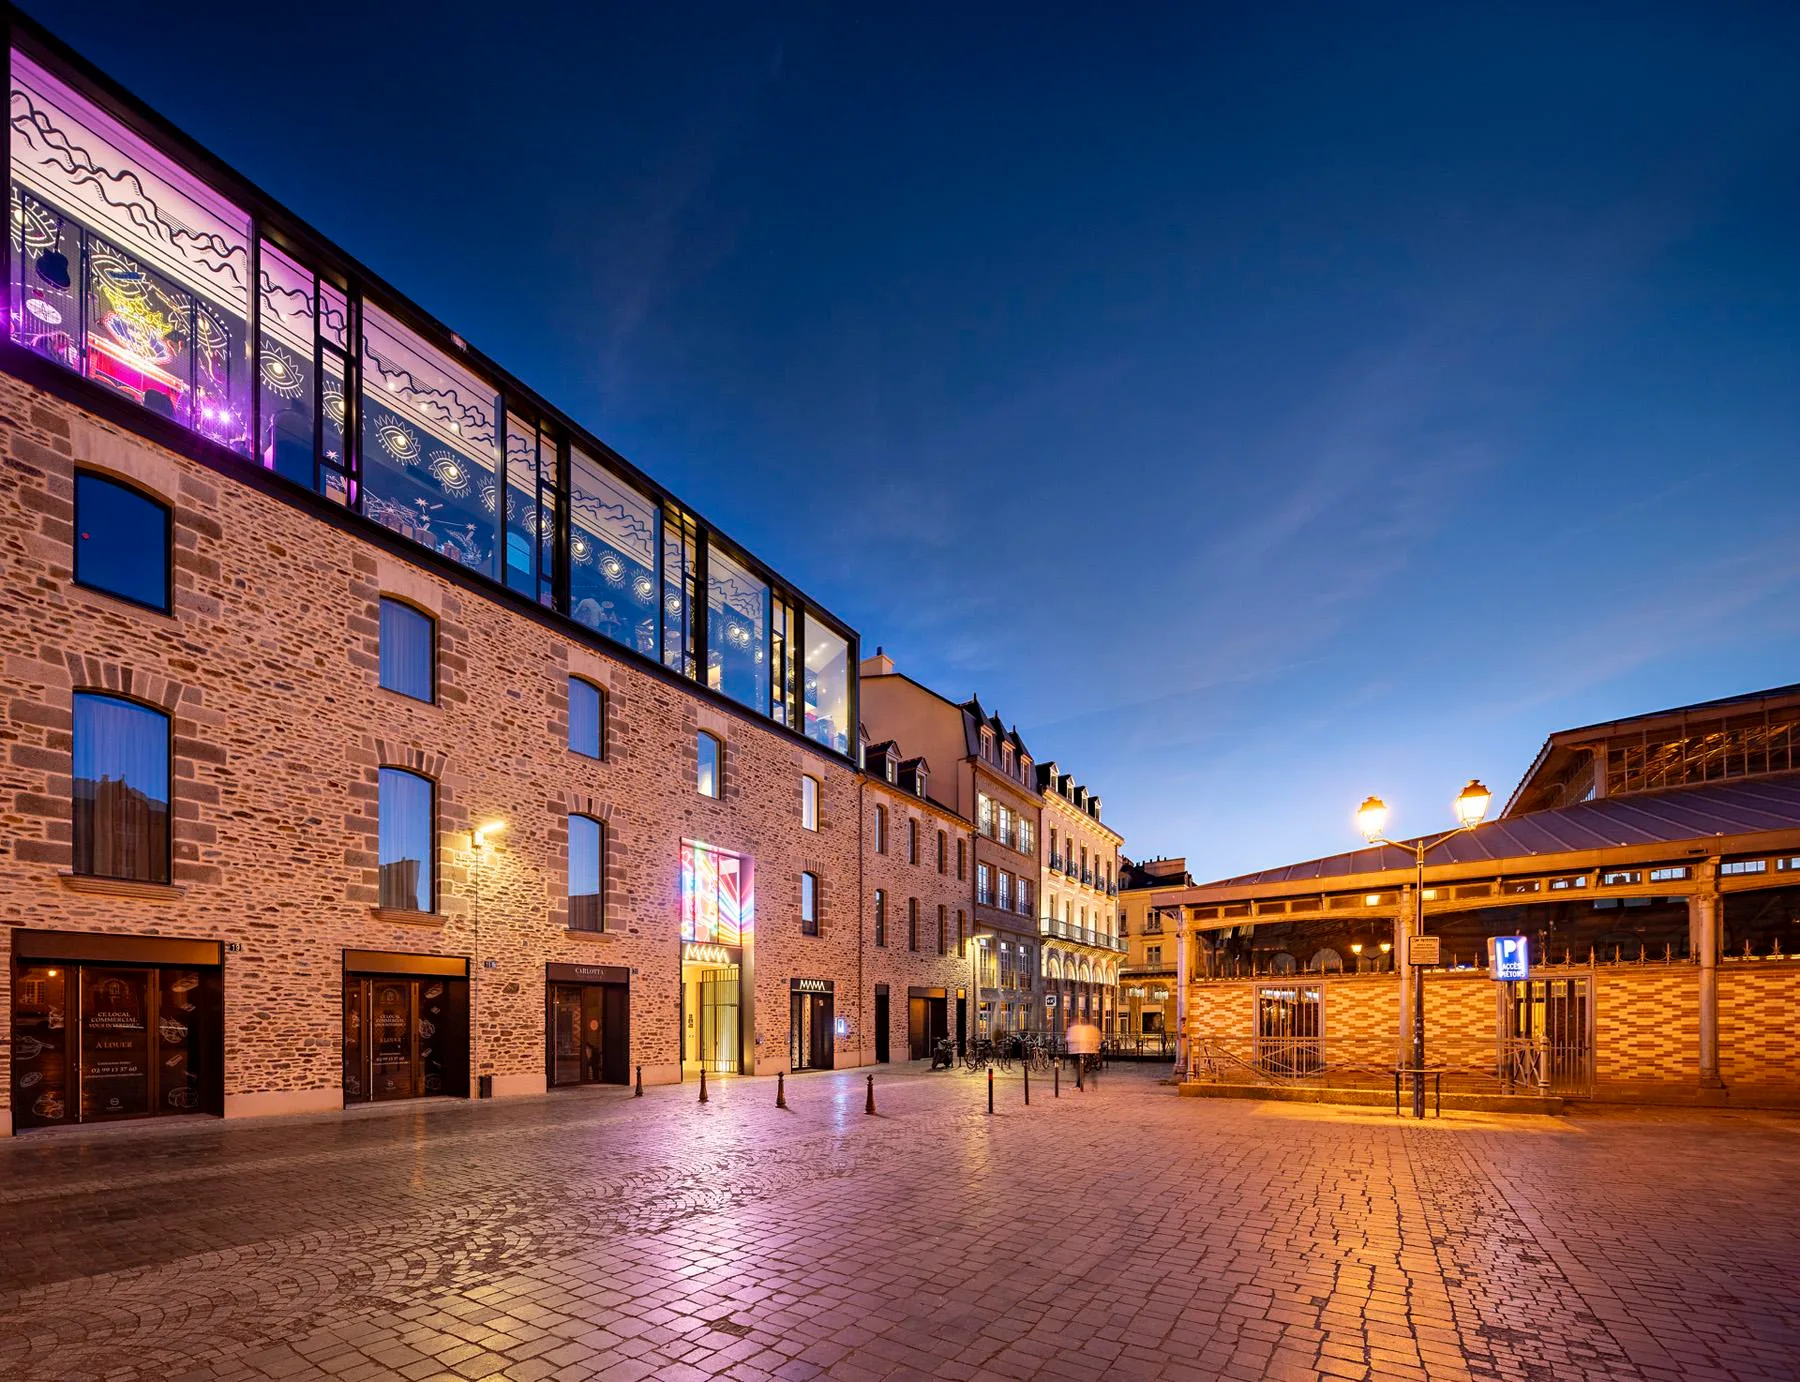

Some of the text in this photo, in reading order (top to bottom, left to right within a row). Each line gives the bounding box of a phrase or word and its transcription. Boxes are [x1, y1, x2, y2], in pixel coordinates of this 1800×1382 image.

[685, 943, 730, 963] MAMA
[1503, 939, 1517, 958] P
[575, 967, 604, 975] CARLOTTA
[799, 979, 826, 991] MAMA
